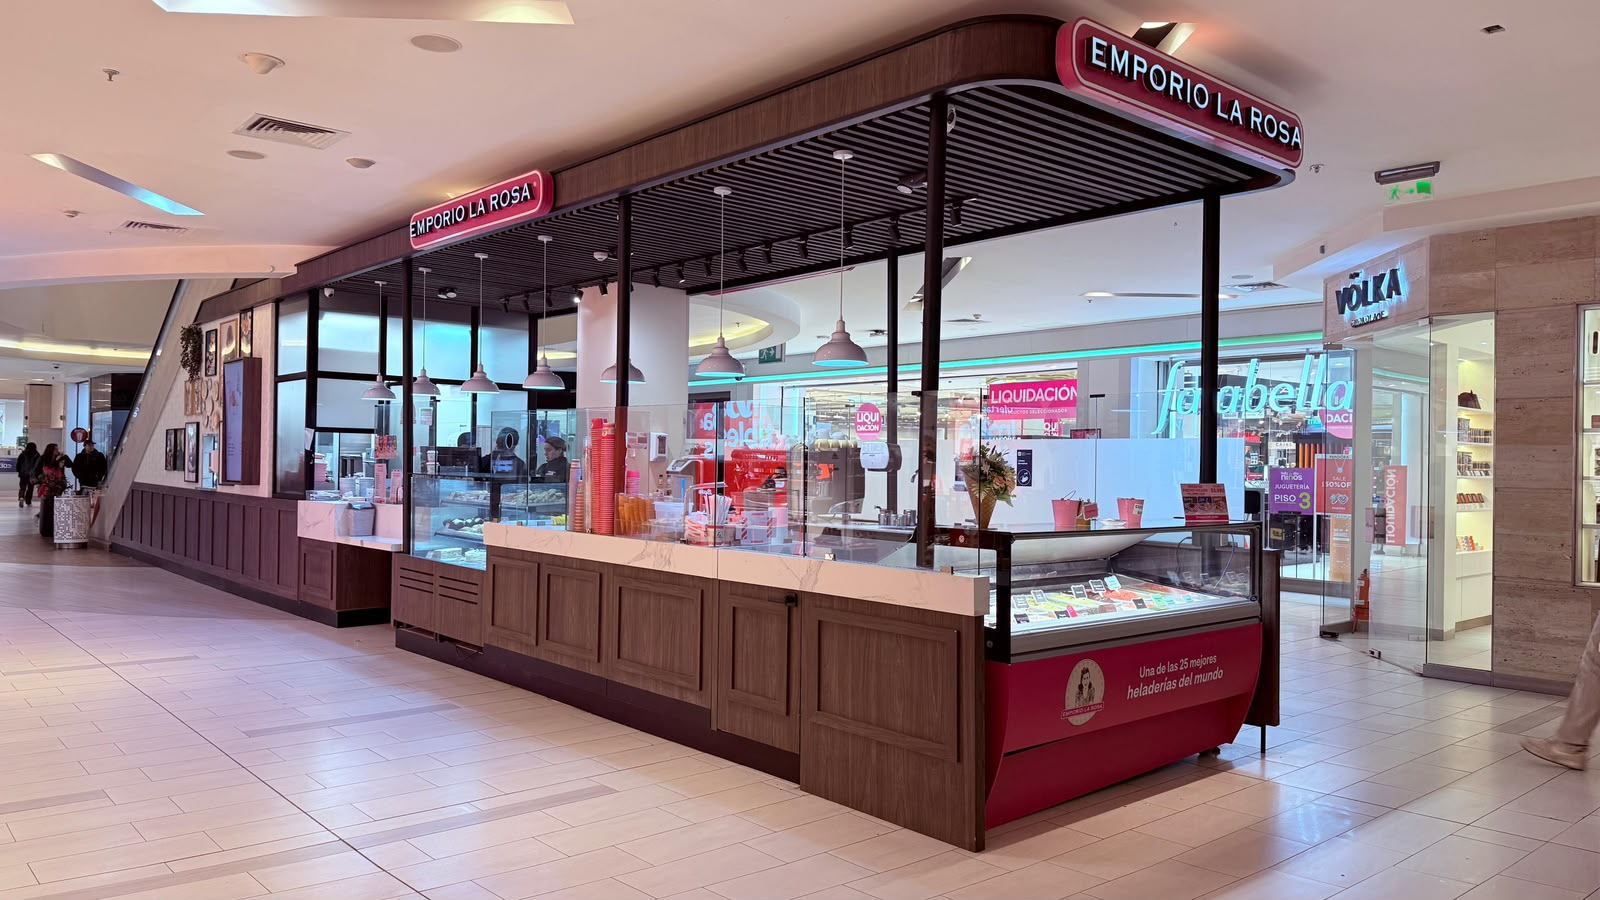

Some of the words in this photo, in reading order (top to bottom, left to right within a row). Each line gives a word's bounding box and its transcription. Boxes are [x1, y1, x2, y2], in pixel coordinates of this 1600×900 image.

[1090, 36, 1209, 109] EMPORIO
[1215, 92, 1243, 125] LA
[1249, 106, 1302, 150] ROSA
[409, 204, 465, 237] EMPORIO
[469, 198, 485, 218] LA
[490, 182, 531, 211] ROSA
[991, 384, 1077, 404] LIQUIDACIÓN
[1151, 354, 1354, 435] faabella
[856, 412, 879, 424] LIQUI
[856, 422, 879, 431] DACIÓN
[1274, 494, 1297, 502] PISO
[1298, 491, 1312, 510] 3
[1139, 666, 1155, 678] Una
[1156, 662, 1166, 675] de
[1167, 661, 1179, 673] las
[1179, 658, 1188, 670] 25
[1189, 654, 1217, 669] mejores
[1127, 677, 1177, 700] heladerías
[1178, 672, 1193, 688] del
[1194, 666, 1224, 685] mundo
[1062, 708, 1083, 717] EMPORIO
